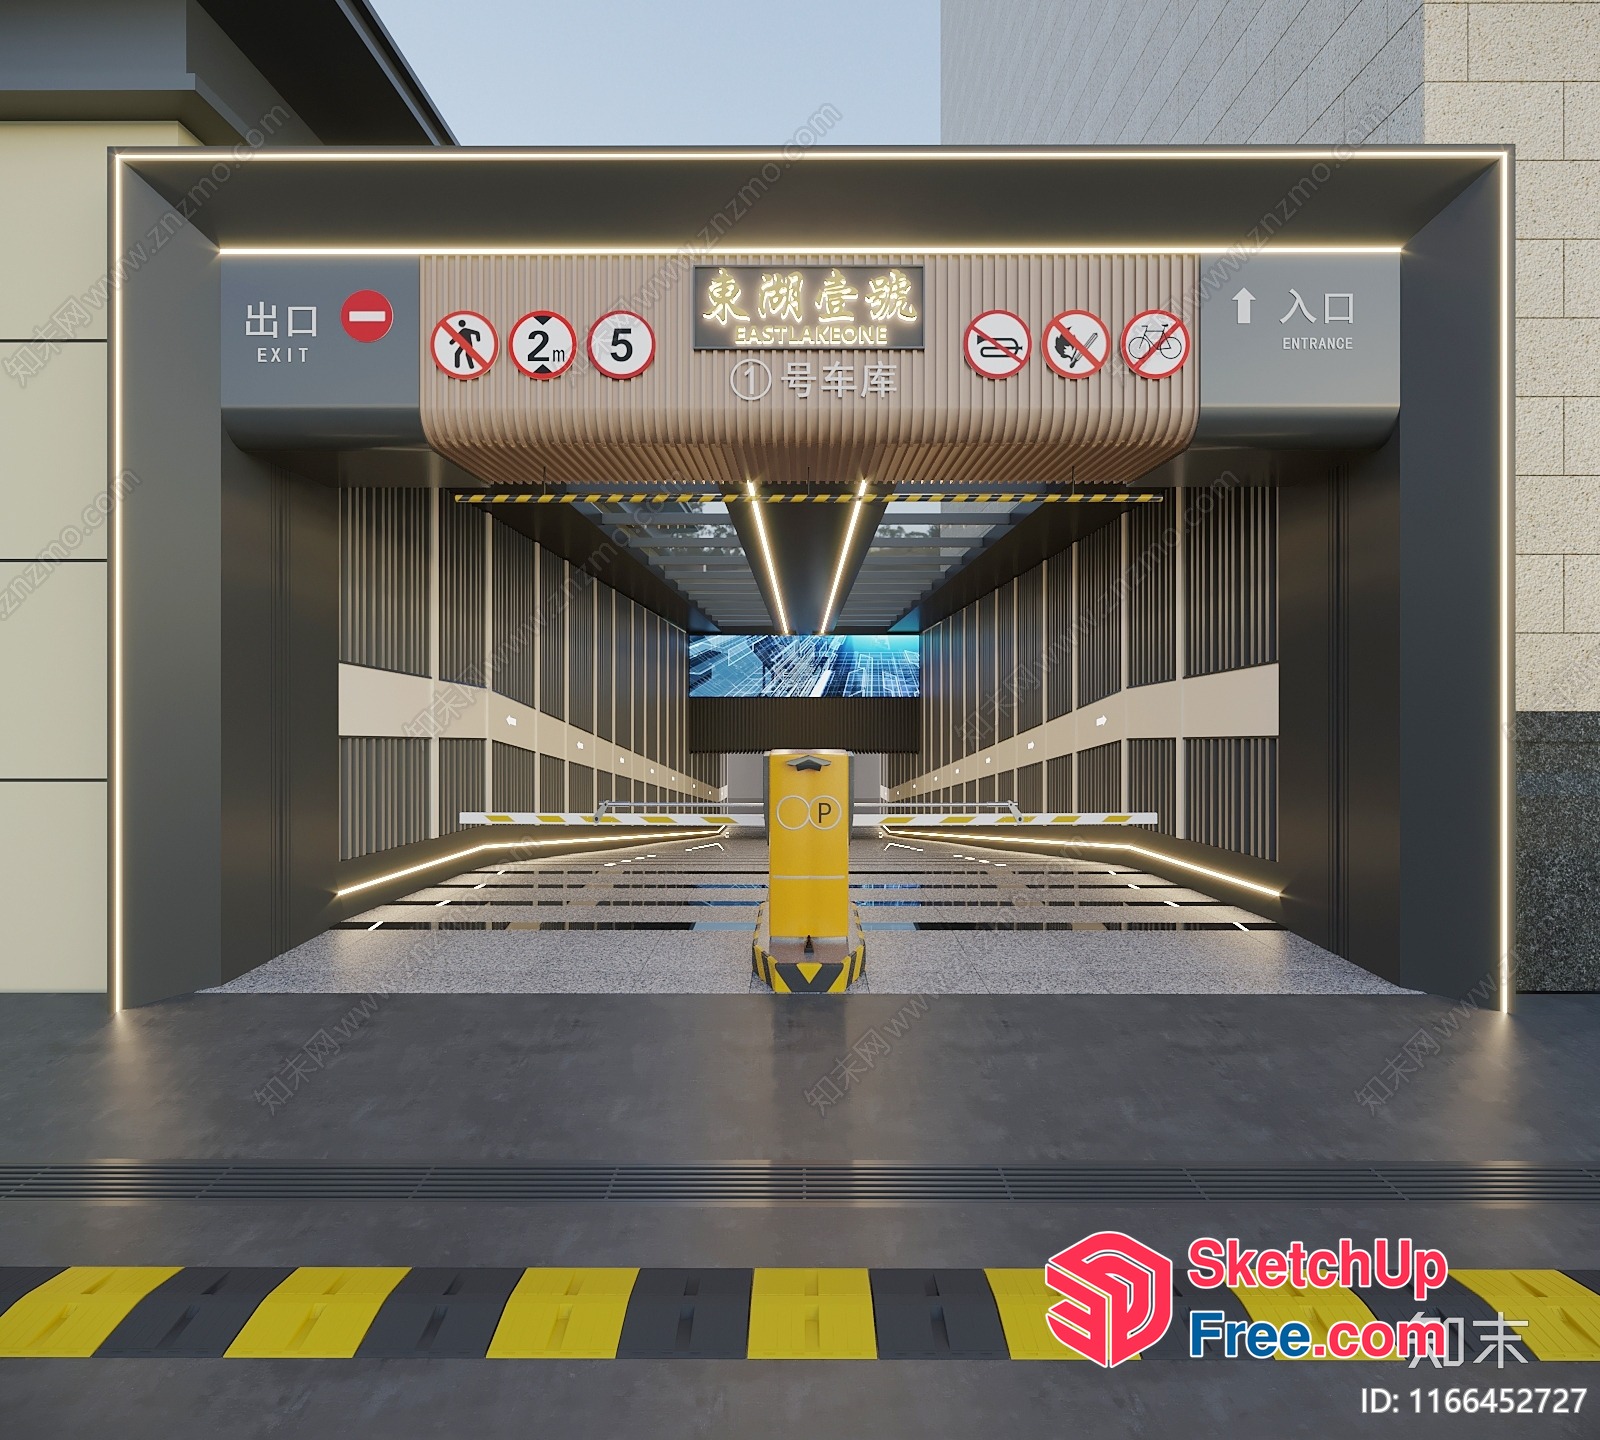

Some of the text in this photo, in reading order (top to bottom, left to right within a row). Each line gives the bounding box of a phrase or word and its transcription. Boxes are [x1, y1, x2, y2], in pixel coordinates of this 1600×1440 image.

[702, 268, 917, 325] 東湖壹號
[1279, 288, 1354, 324] 入口
[245, 301, 317, 339] 出口
[610, 328, 633, 362] 5
[735, 325, 888, 345] EASTLAKEONE
[1282, 337, 1353, 350] ENTRANCE
[257, 347, 309, 363] EXIT
[818, 802, 832, 824] P
